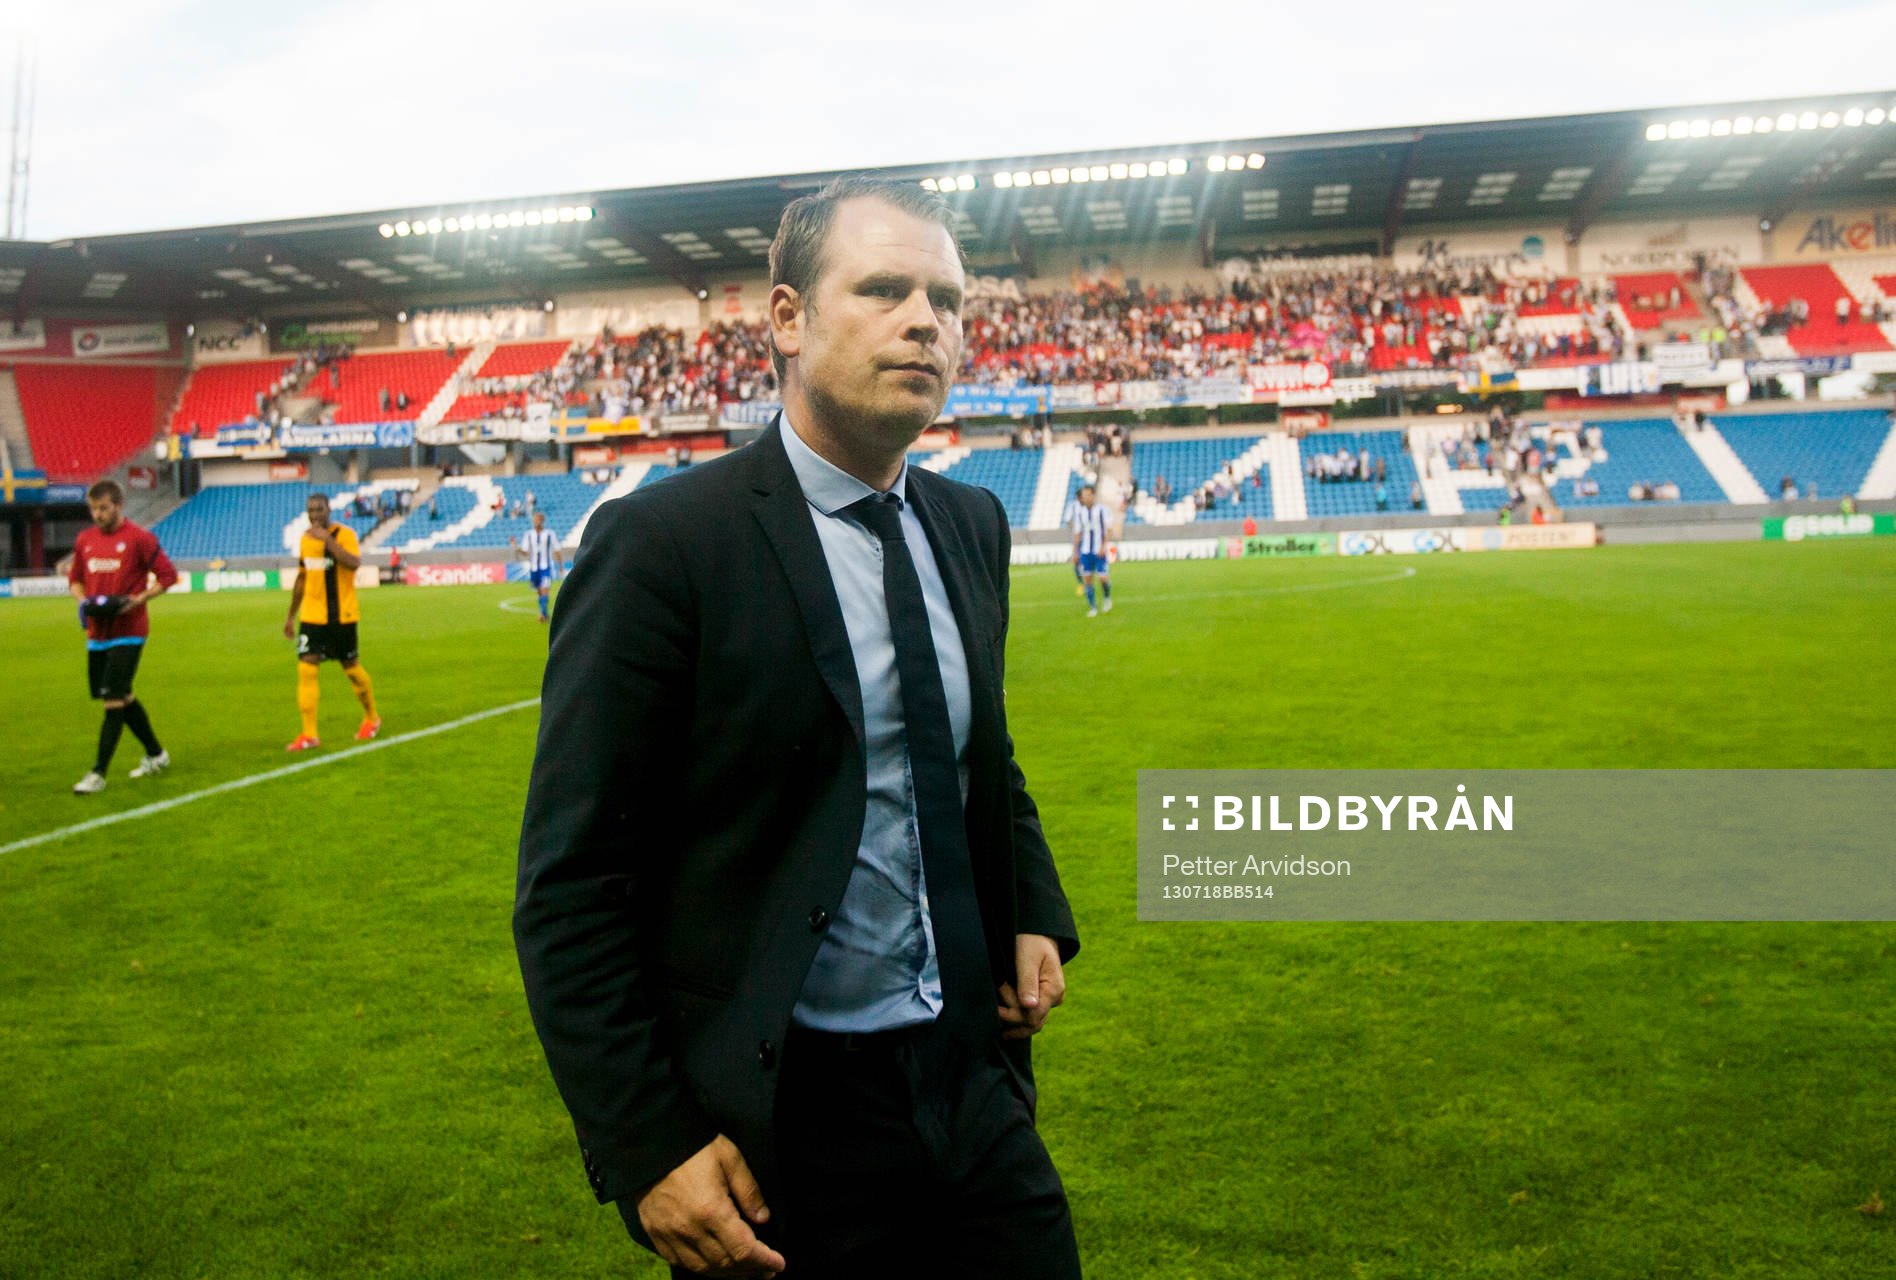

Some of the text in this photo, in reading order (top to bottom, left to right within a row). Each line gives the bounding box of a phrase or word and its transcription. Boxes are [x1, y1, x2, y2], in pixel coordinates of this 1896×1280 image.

[1795, 212, 1896, 254] Akeli
[199, 336, 240, 351] NCC
[1247, 537, 1315, 555] Stroller
[417, 562, 493, 587] Scandic
